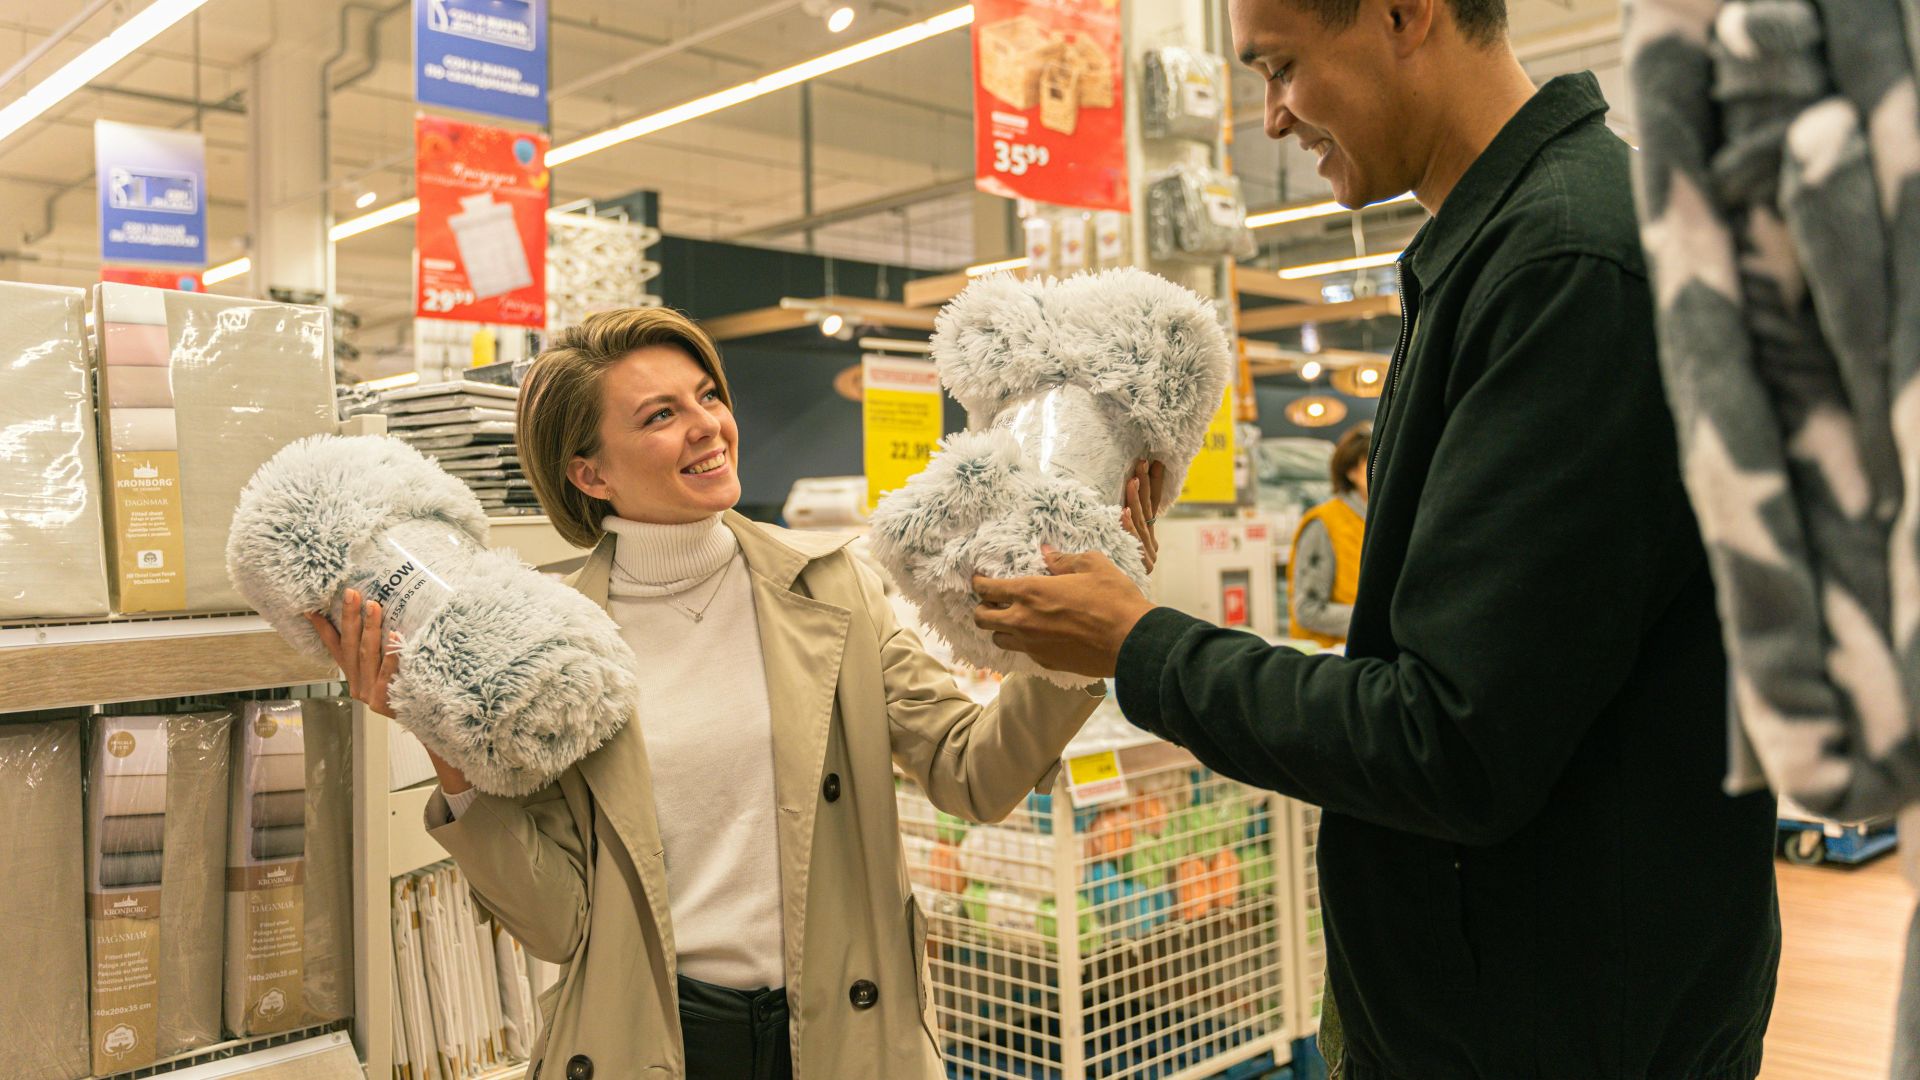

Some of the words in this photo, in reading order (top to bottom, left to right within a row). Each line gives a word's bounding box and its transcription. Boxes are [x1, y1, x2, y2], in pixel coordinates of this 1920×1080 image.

[117, 478, 173, 488] KRONBORG
[374, 561, 414, 608] HROW
[390, 589, 415, 621] 135x195
[414, 578, 427, 591] cm
[104, 906, 148, 915] KRONBORG
[252, 900, 294, 912] DAGNMAR
[97, 931, 147, 944] DAGNMAR
